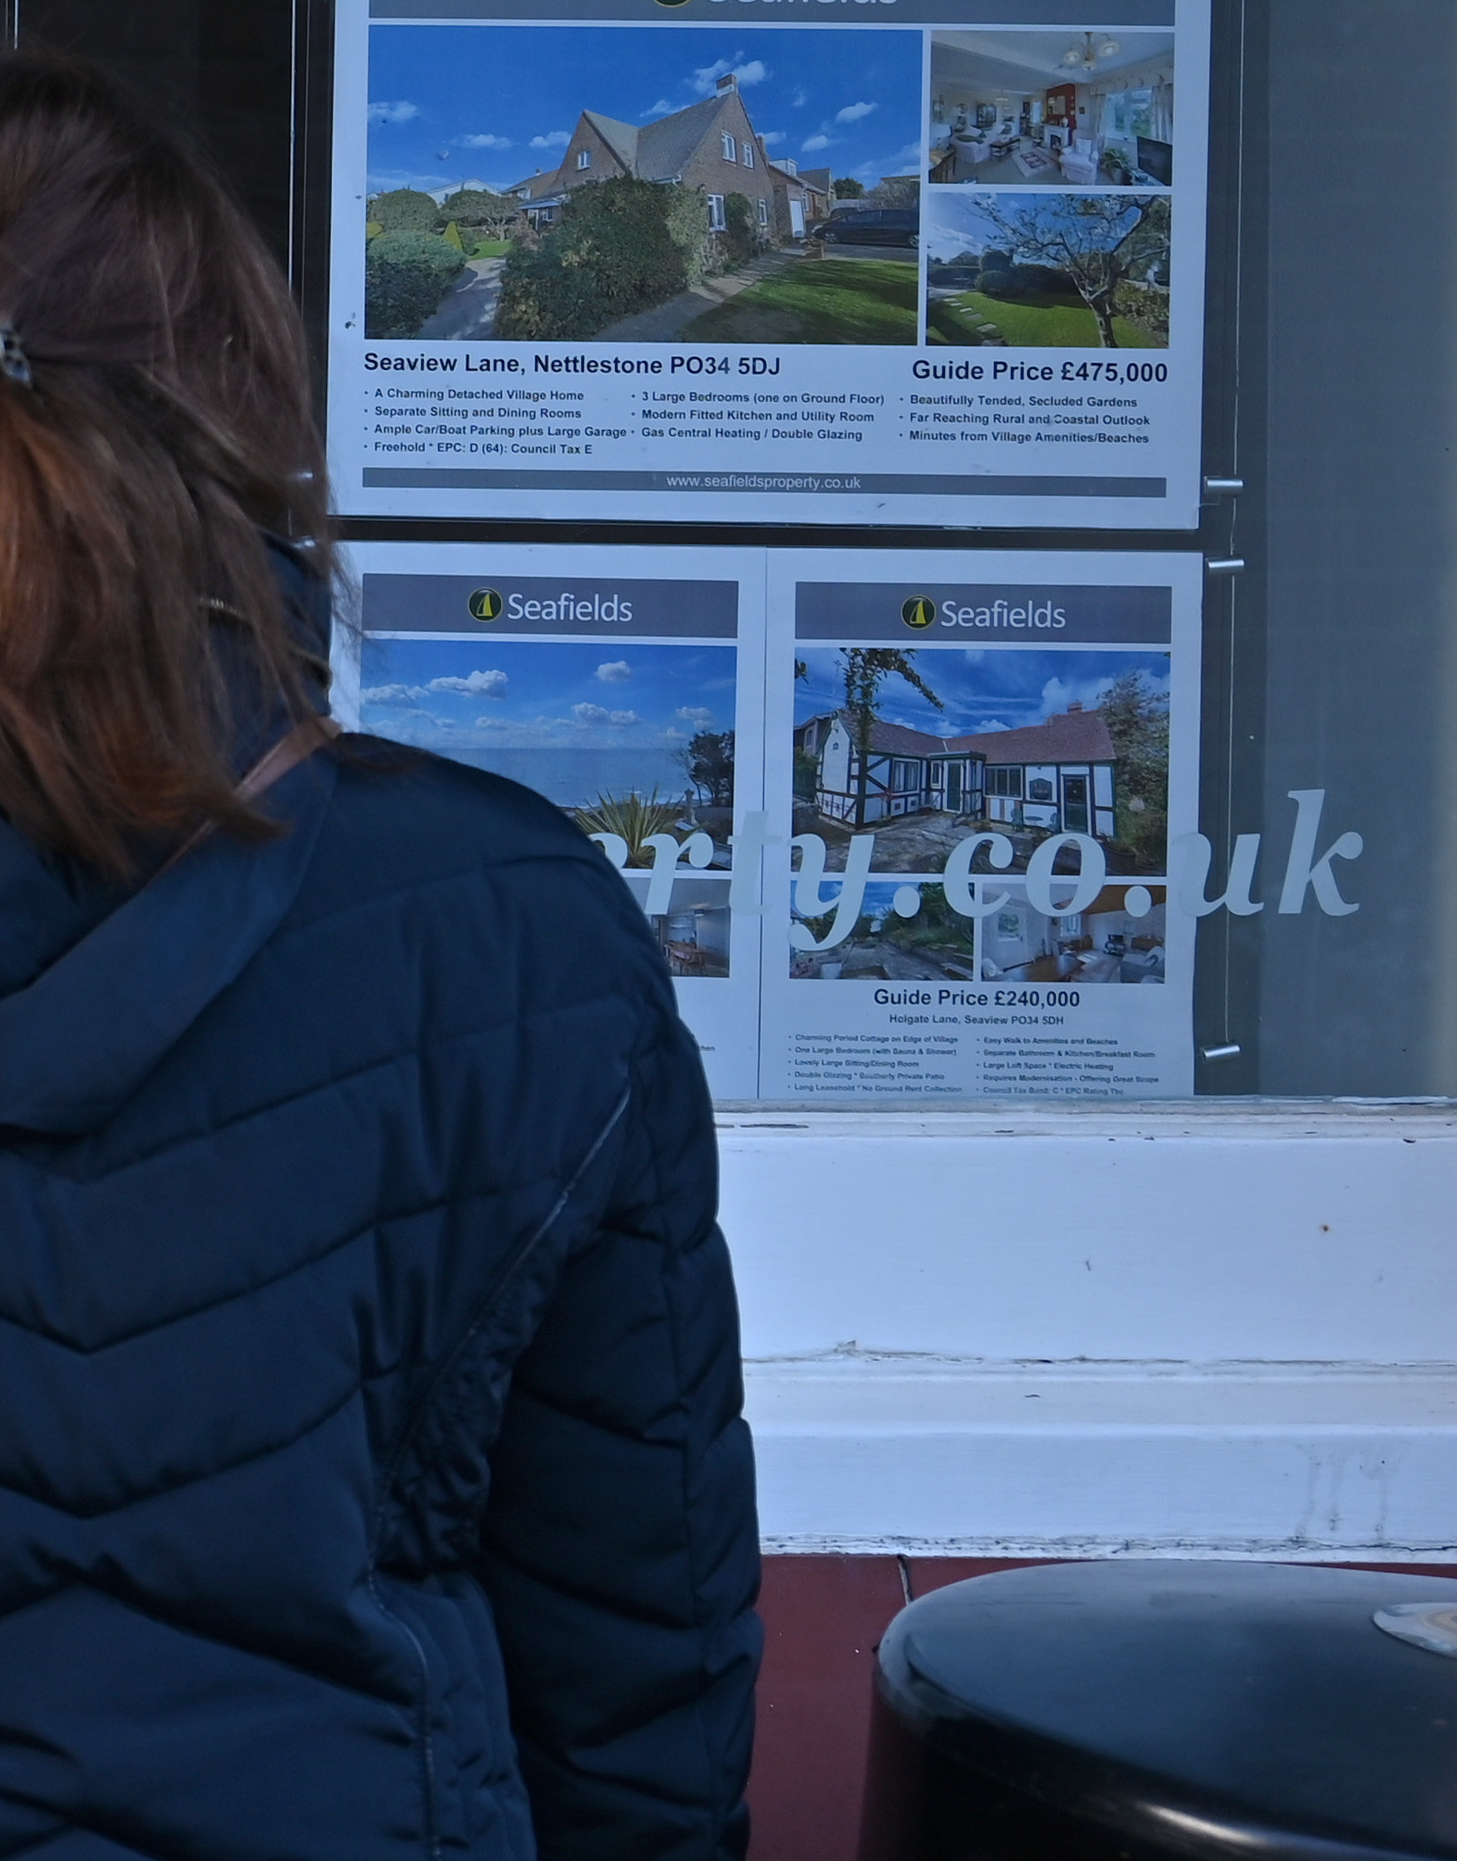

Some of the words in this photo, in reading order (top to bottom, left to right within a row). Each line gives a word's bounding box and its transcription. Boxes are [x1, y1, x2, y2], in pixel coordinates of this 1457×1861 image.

[363, 352, 458, 372] Seaview
[464, 353, 526, 376] Lane,
[534, 354, 663, 374] Nettlestone
[670, 355, 731, 375] PO34
[737, 356, 780, 375] 5DJ
[911, 359, 984, 380] Guide
[992, 360, 1054, 381] Price
[1060, 361, 1168, 385] £475,000
[908, 429, 957, 441] Minutes
[959, 430, 988, 441] from
[990, 430, 1032, 444] Village
[1034, 431, 1149, 443] Amenities/Beaches
[665, 474, 861, 491] www.seafieldsproperty.co.uk
[507, 592, 633, 622] Seafields
[940, 599, 1066, 628] Seafields
[873, 988, 932, 1005] Guide
[937, 988, 988, 1006] Price
[993, 989, 1080, 1010] £240,000
[931, 1014, 961, 1025] Lane,
[963, 1014, 1008, 1025] Seaview
[1010, 1015, 1039, 1025] PO34
